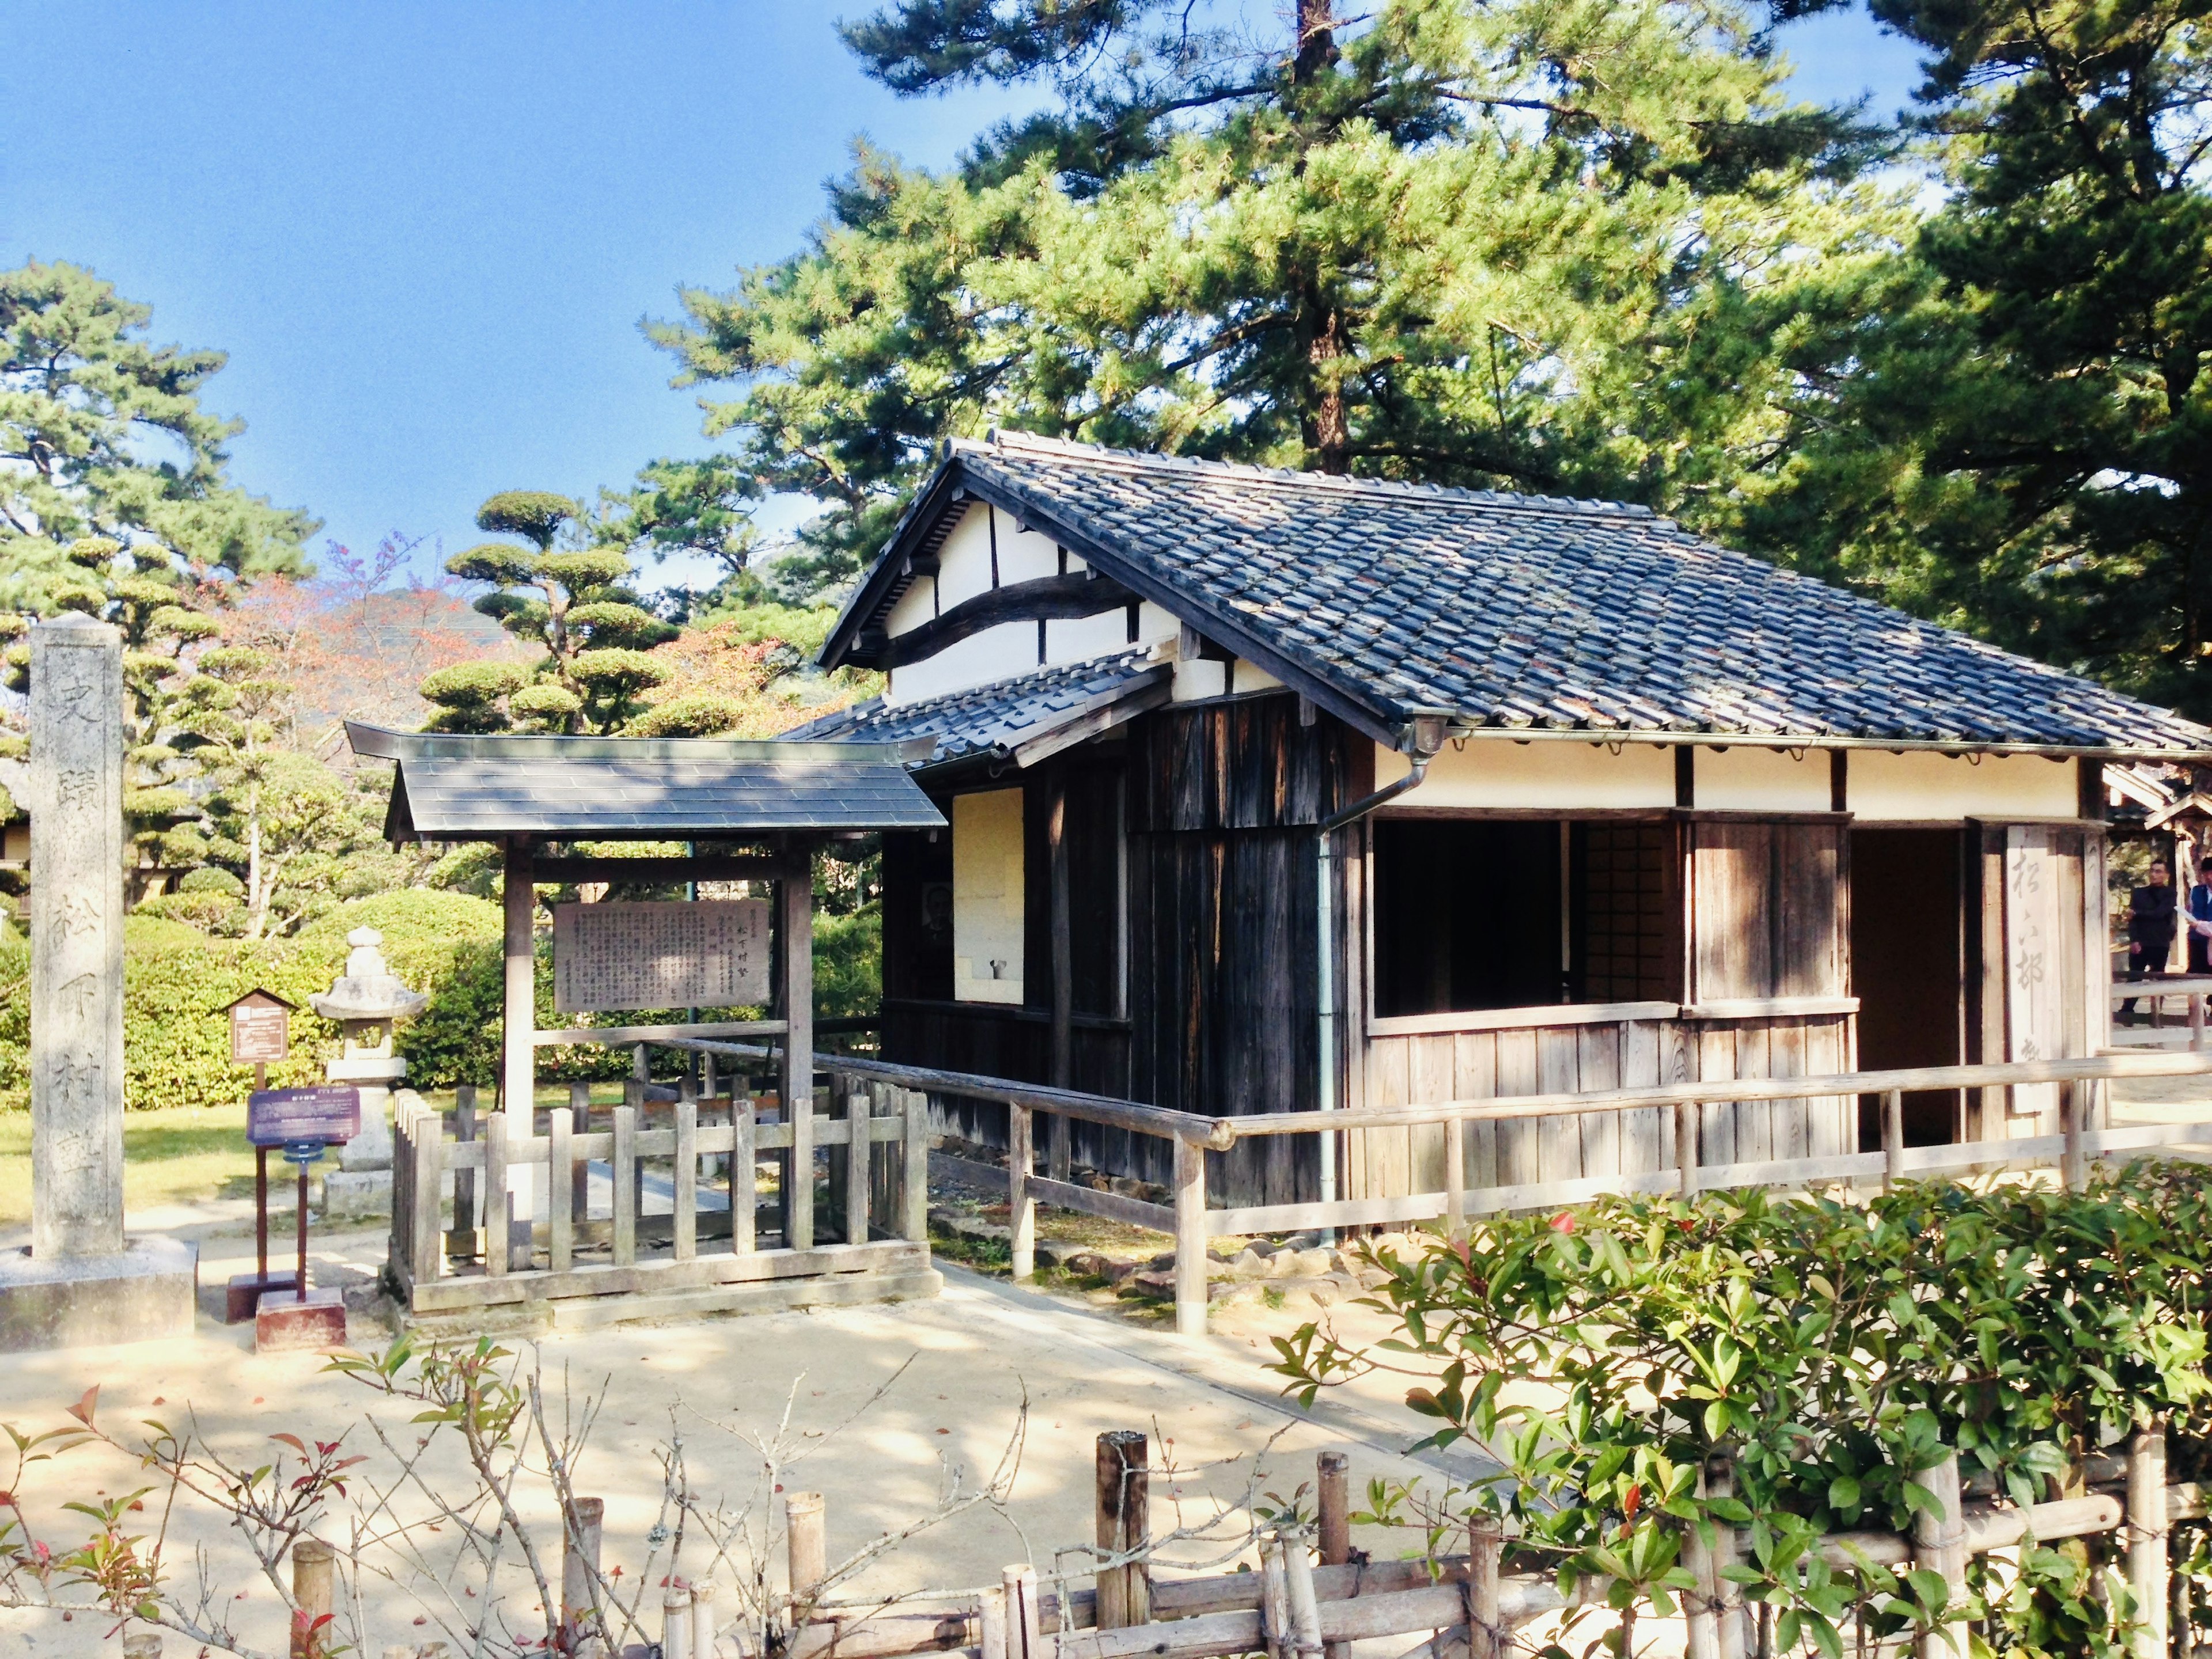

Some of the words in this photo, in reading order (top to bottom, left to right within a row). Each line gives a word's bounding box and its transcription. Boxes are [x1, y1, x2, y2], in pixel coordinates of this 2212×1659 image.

[53, 893, 102, 1174] 松下村塾
[737, 926, 749, 978] 松下村塾
